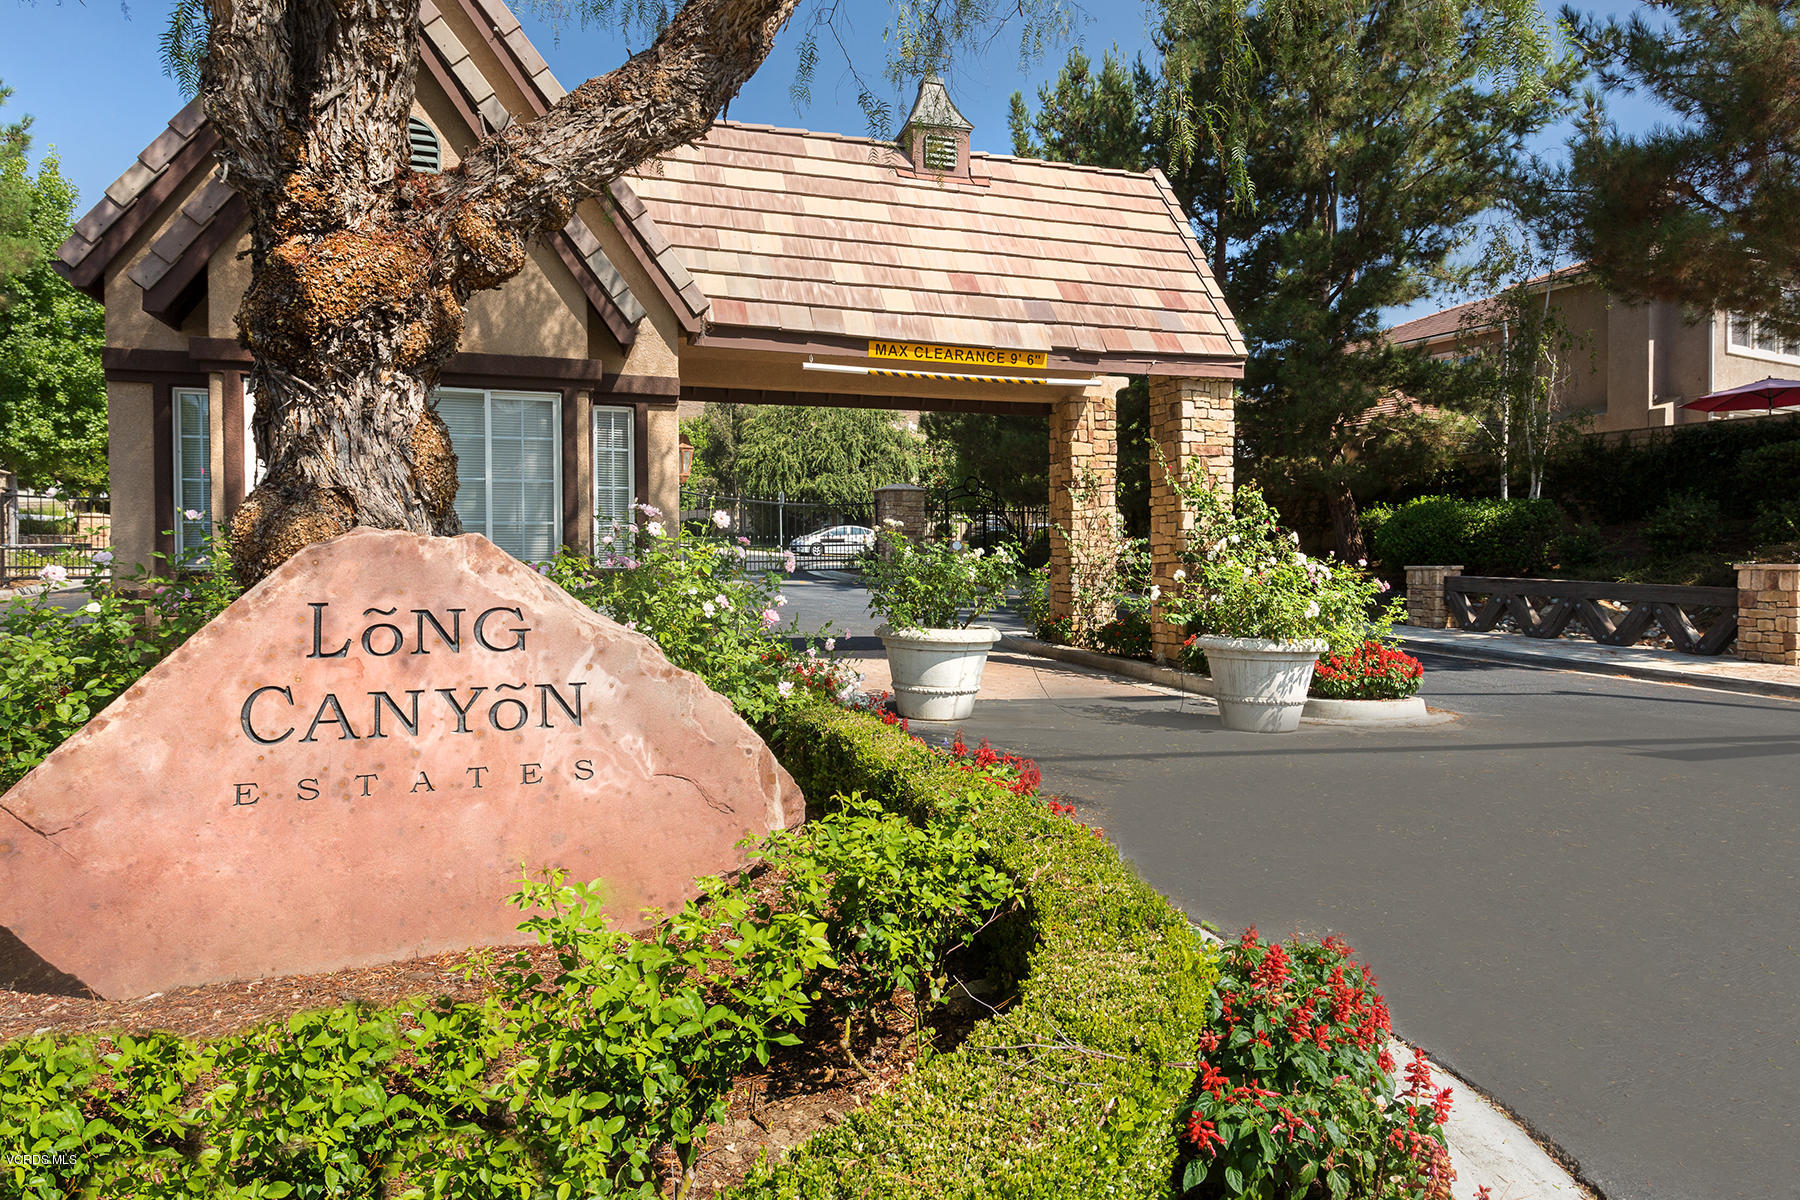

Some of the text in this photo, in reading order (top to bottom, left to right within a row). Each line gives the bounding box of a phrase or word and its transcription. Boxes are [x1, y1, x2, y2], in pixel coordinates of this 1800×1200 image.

[875, 343, 1041, 366] MAX CLEARANCE 9' 6"
[232, 759, 594, 806] ESTATES
